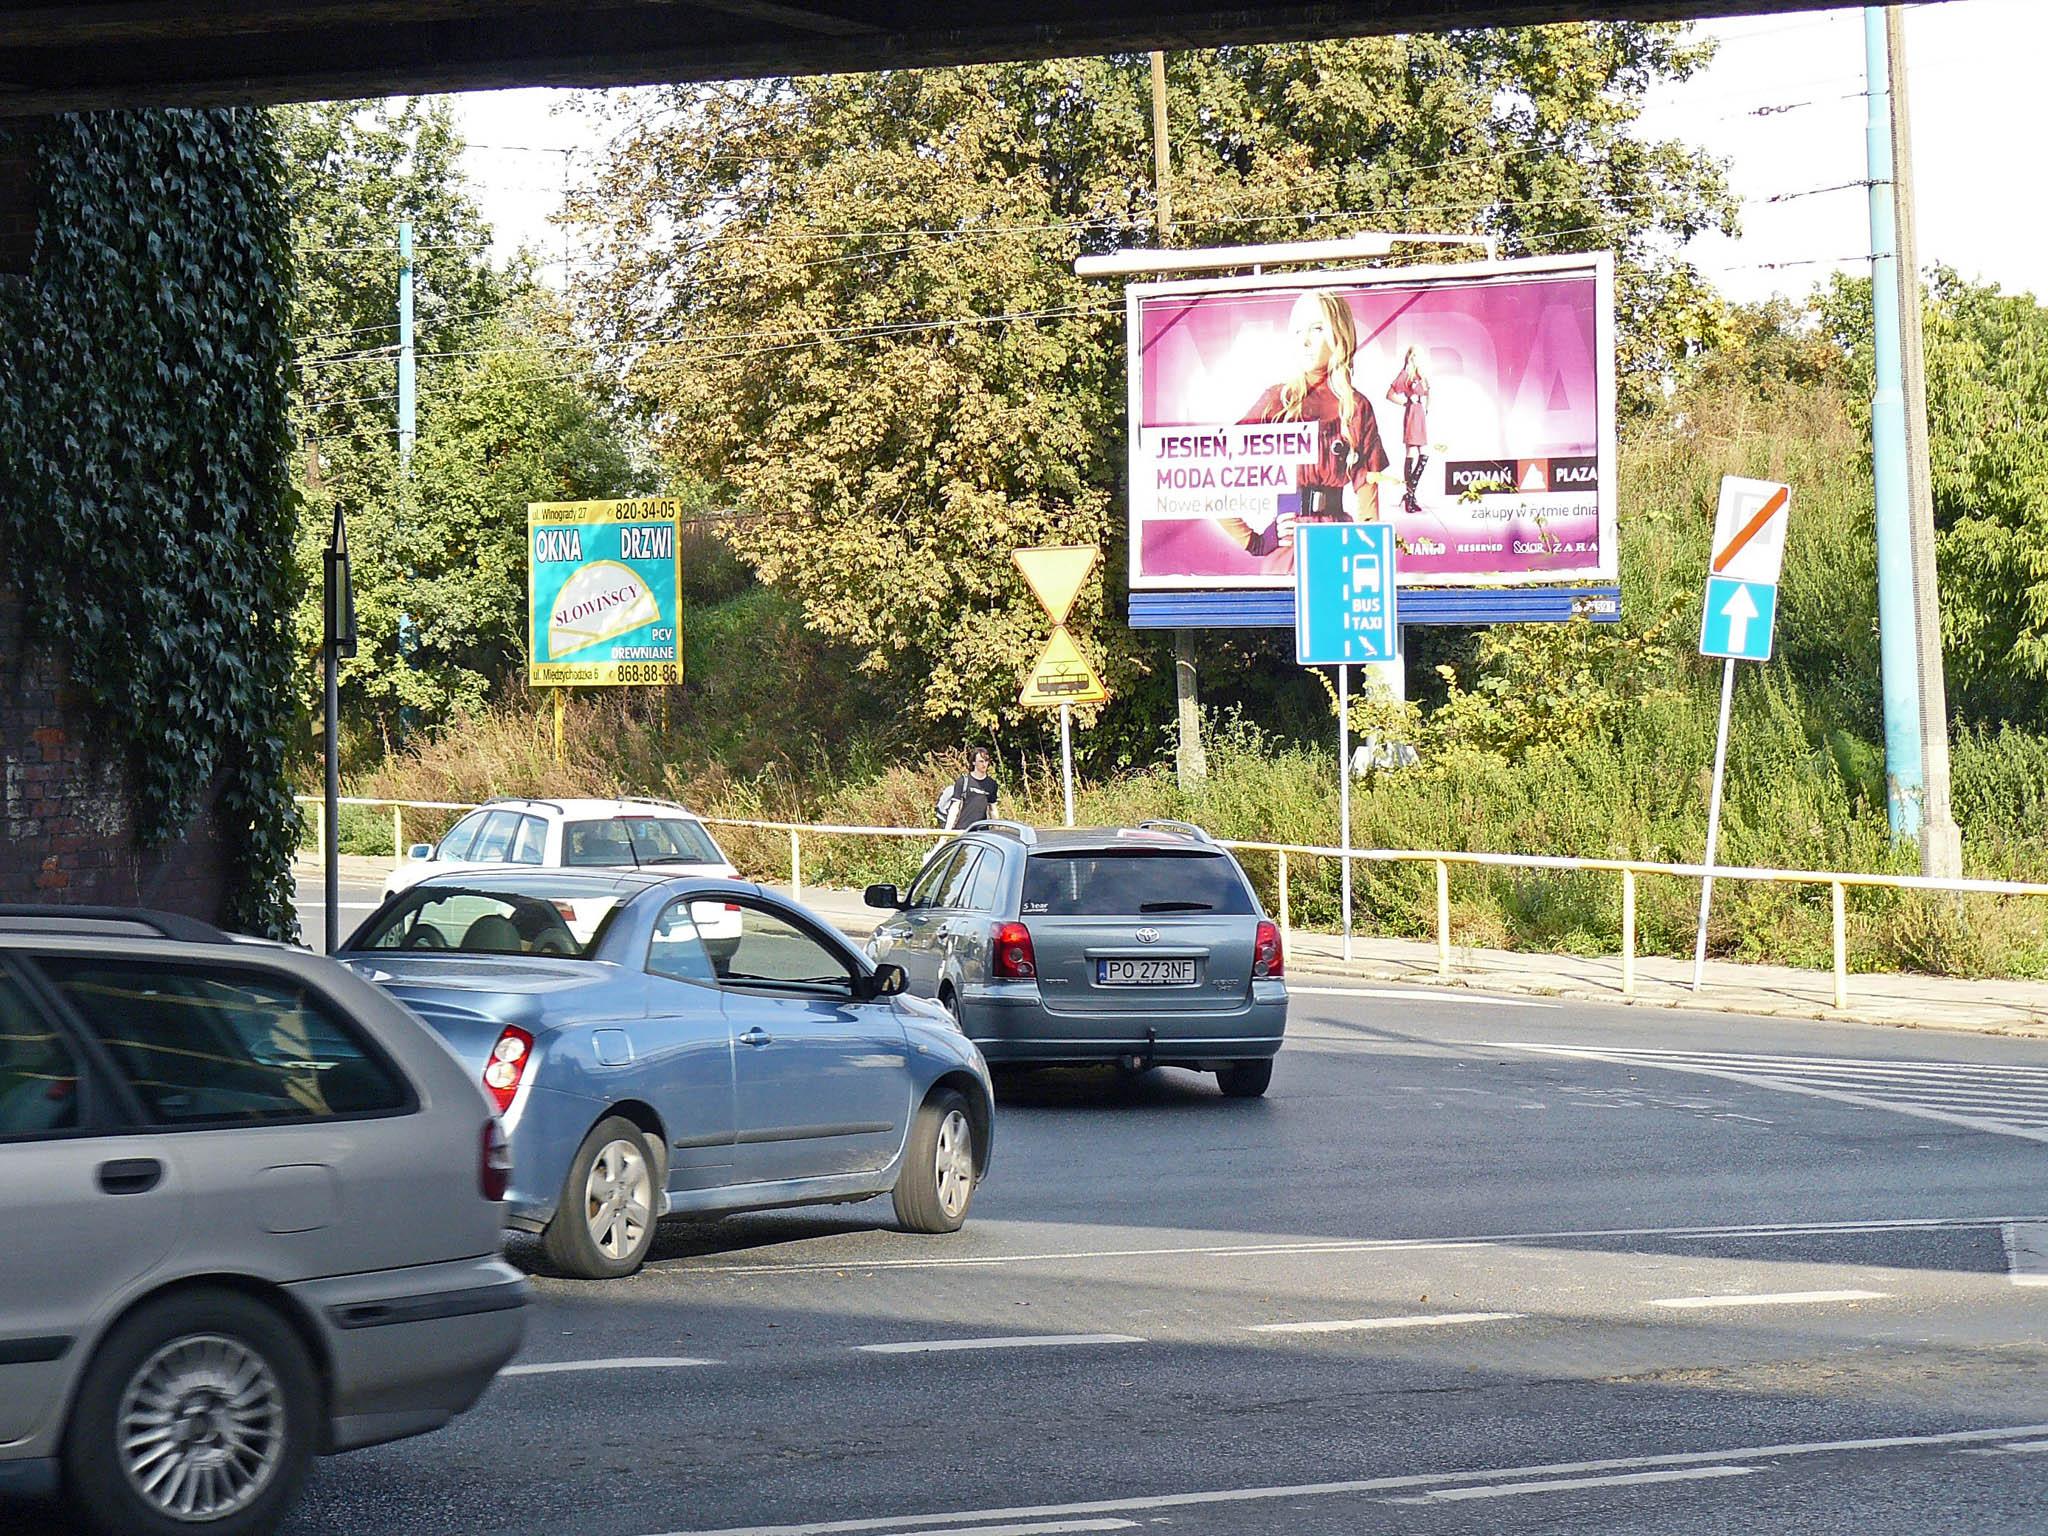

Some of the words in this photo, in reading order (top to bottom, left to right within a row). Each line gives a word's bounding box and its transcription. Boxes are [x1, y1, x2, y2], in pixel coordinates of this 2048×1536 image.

[1156, 428, 1232, 460] JESIEŃ,
[1238, 425, 1312, 456] JESIEŃ
[1157, 467, 1216, 489] MODA
[1221, 465, 1288, 487] CZEKA
[1452, 467, 1512, 485] POZNAŃ
[1556, 466, 1598, 482] PLAZA
[578, 507, 587, 519] 27
[615, 501, 675, 520] 820-34-05
[1157, 496, 1200, 512] Nowe
[1205, 494, 1271, 515] kolekcje
[1471, 507, 1513, 521] zakupy
[1516, 508, 1526, 518] w
[1572, 504, 1598, 516] dnia
[535, 529, 583, 563] OKNA
[620, 526, 673, 560] DRZWI
[1553, 542, 1598, 553] ZARA
[1352, 598, 1380, 612] BUS
[1352, 616, 1383, 630] TAXI
[651, 628, 673, 641] PCV
[611, 647, 675, 659] DREWNIANE
[617, 664, 677, 682] 868-88-86
[1109, 962, 1134, 978] PO
[1140, 962, 1192, 978] 273NF
